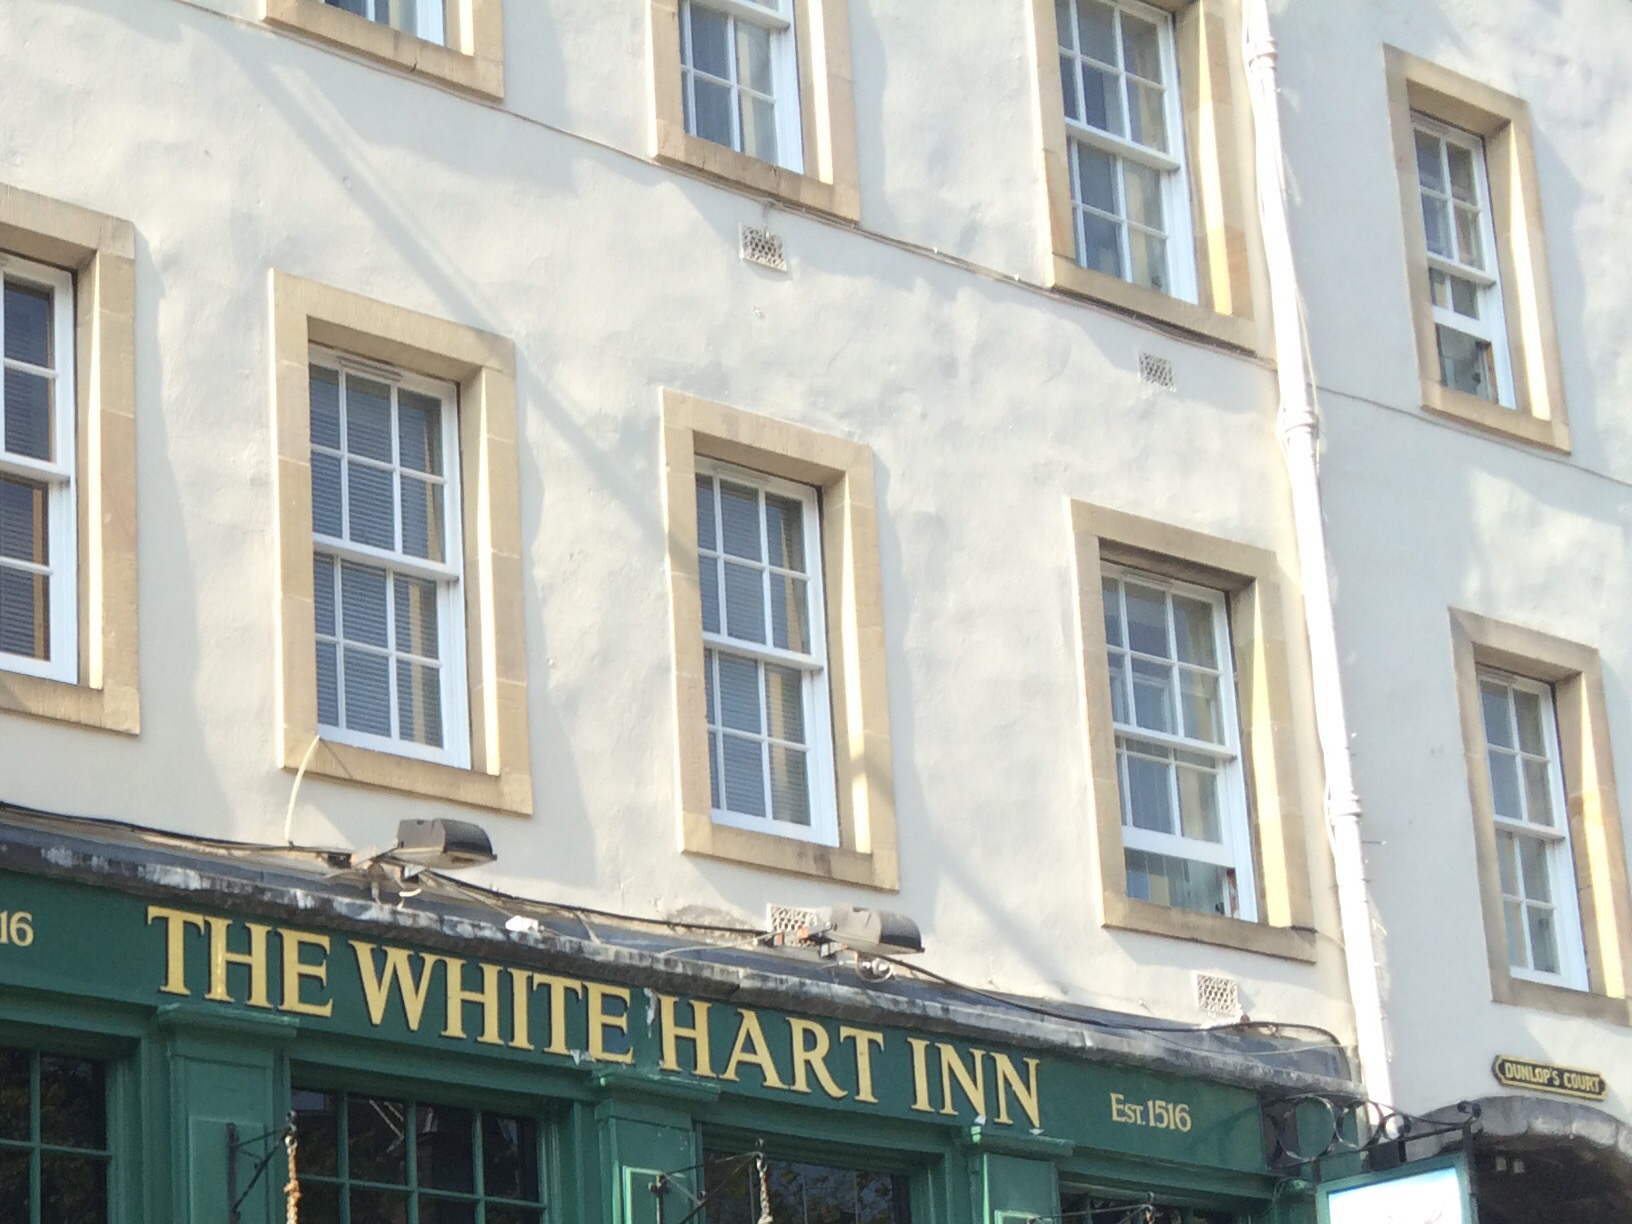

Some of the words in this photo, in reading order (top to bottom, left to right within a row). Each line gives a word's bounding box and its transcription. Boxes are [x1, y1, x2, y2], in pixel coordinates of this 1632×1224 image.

[146, 904, 334, 1018] THE
[348, 938, 635, 1065] WHITE
[657, 994, 885, 1104] HART
[906, 1036, 1041, 1131] INN
[1504, 1062, 1560, 1086] DUNLOP'S
[1563, 1072, 1601, 1093] COURT
[1147, 1099, 1192, 1133] 1516
